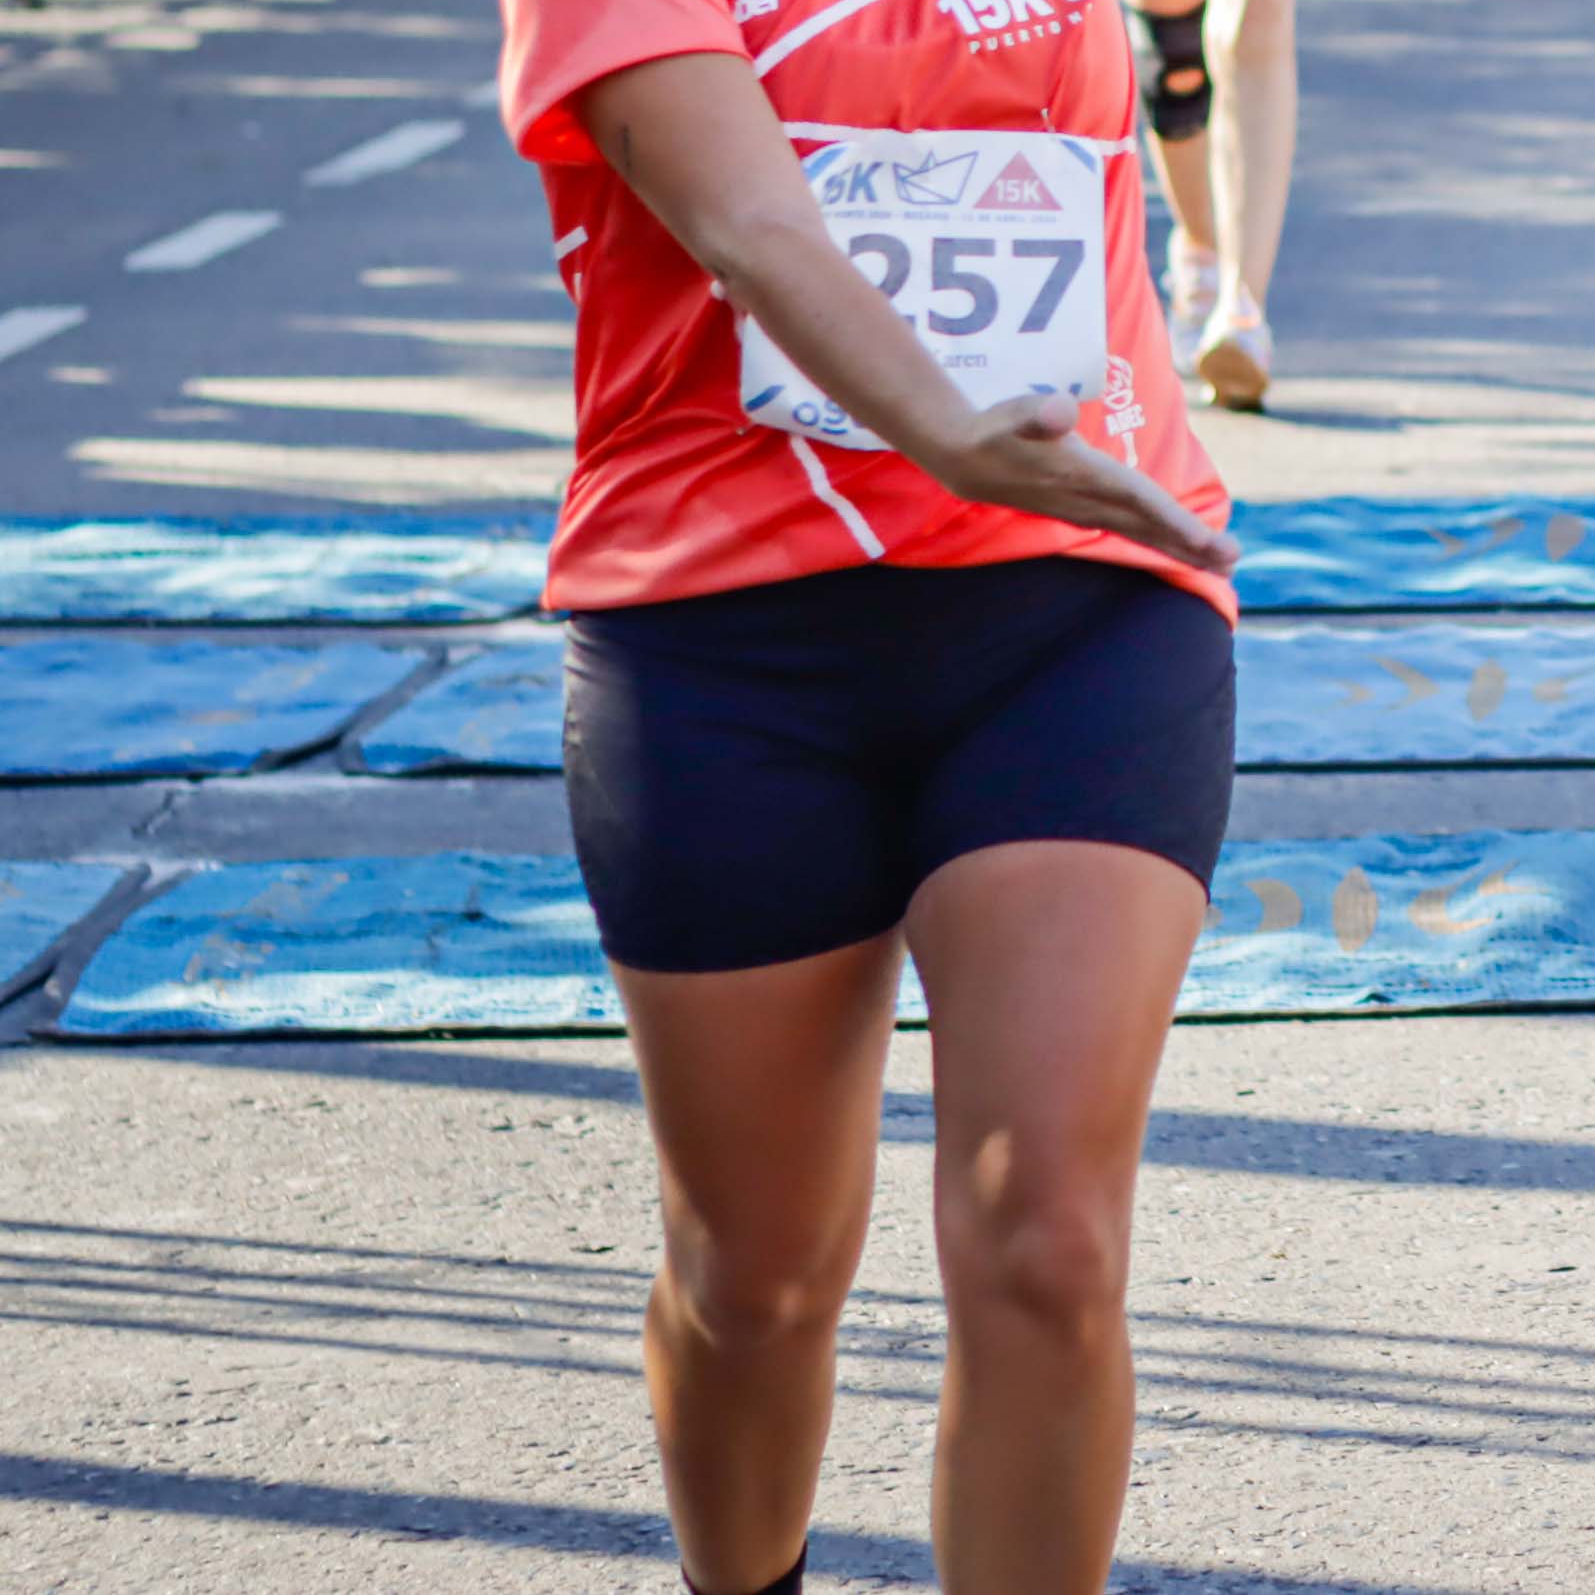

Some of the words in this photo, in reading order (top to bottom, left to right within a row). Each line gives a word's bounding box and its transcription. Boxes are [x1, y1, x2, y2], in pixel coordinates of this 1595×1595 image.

[968, 19, 1062, 55] PUERTO
[994, 180, 1040, 203] 15K
[848, 233, 1085, 335] 257
[792, 400, 849, 434] os
